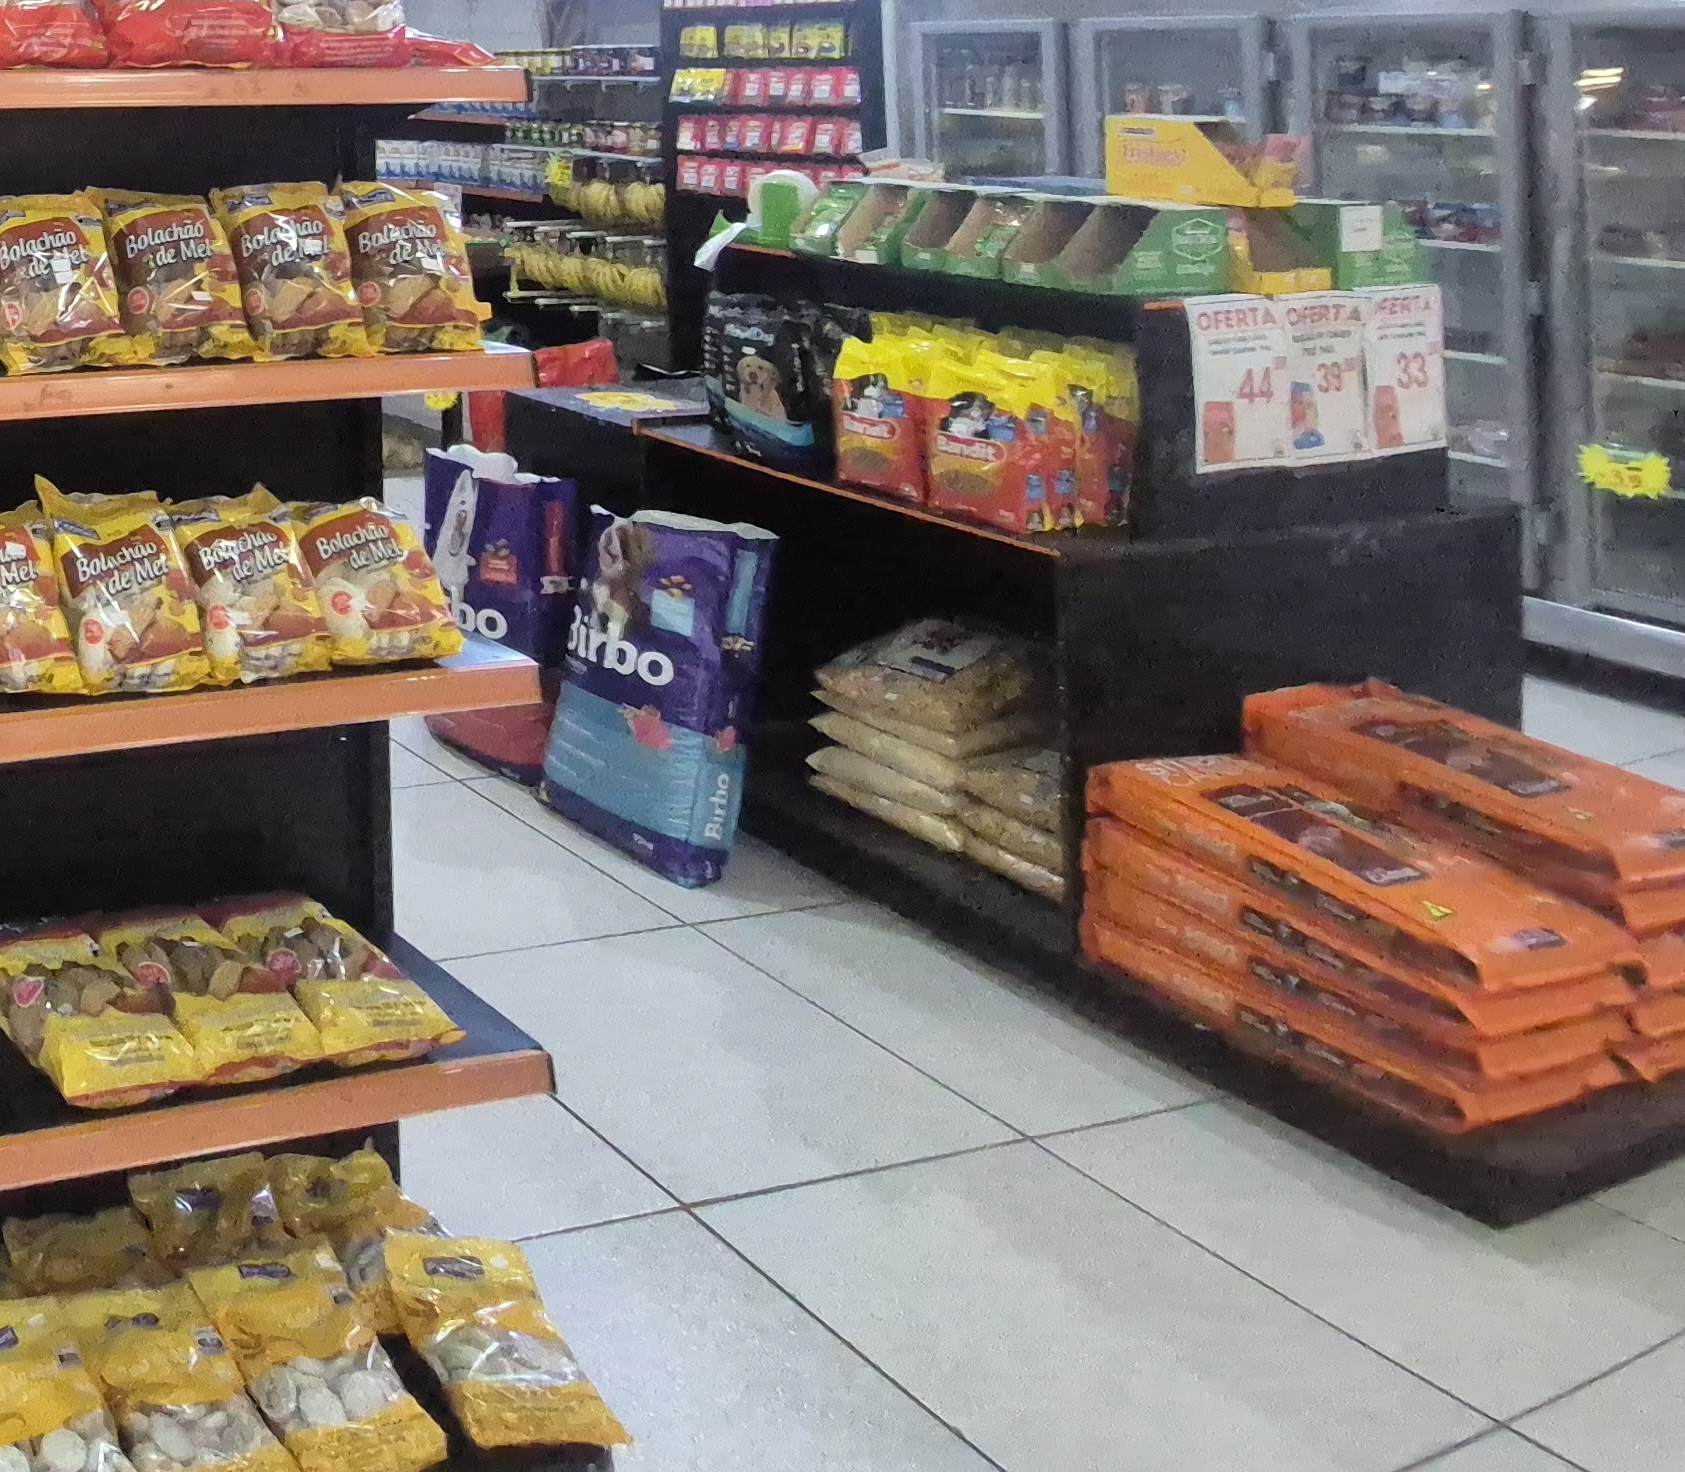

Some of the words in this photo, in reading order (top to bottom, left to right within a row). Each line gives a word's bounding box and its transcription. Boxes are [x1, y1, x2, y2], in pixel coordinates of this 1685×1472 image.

[126, 219, 206, 259] Bolachão
[156, 246, 177, 268] de
[179, 238, 215, 261] Mel
[271, 244, 294, 267] de
[1196, 306, 1278, 332] OFERTA
[1235, 366, 1274, 404] 44
[1316, 361, 1343, 394] 39
[1396, 351, 1430, 390] 33
[316, 522, 389, 561] Bolachão
[348, 548, 372, 570] de
[371, 539, 405, 566] Mel
[0, 559, 38, 589] Mel
[76, 540, 158, 583] Bolachão
[108, 573, 133, 596] de
[133, 554, 169, 582] Mel
[233, 557, 255, 581] de
[704, 772, 731, 841] Birbo
